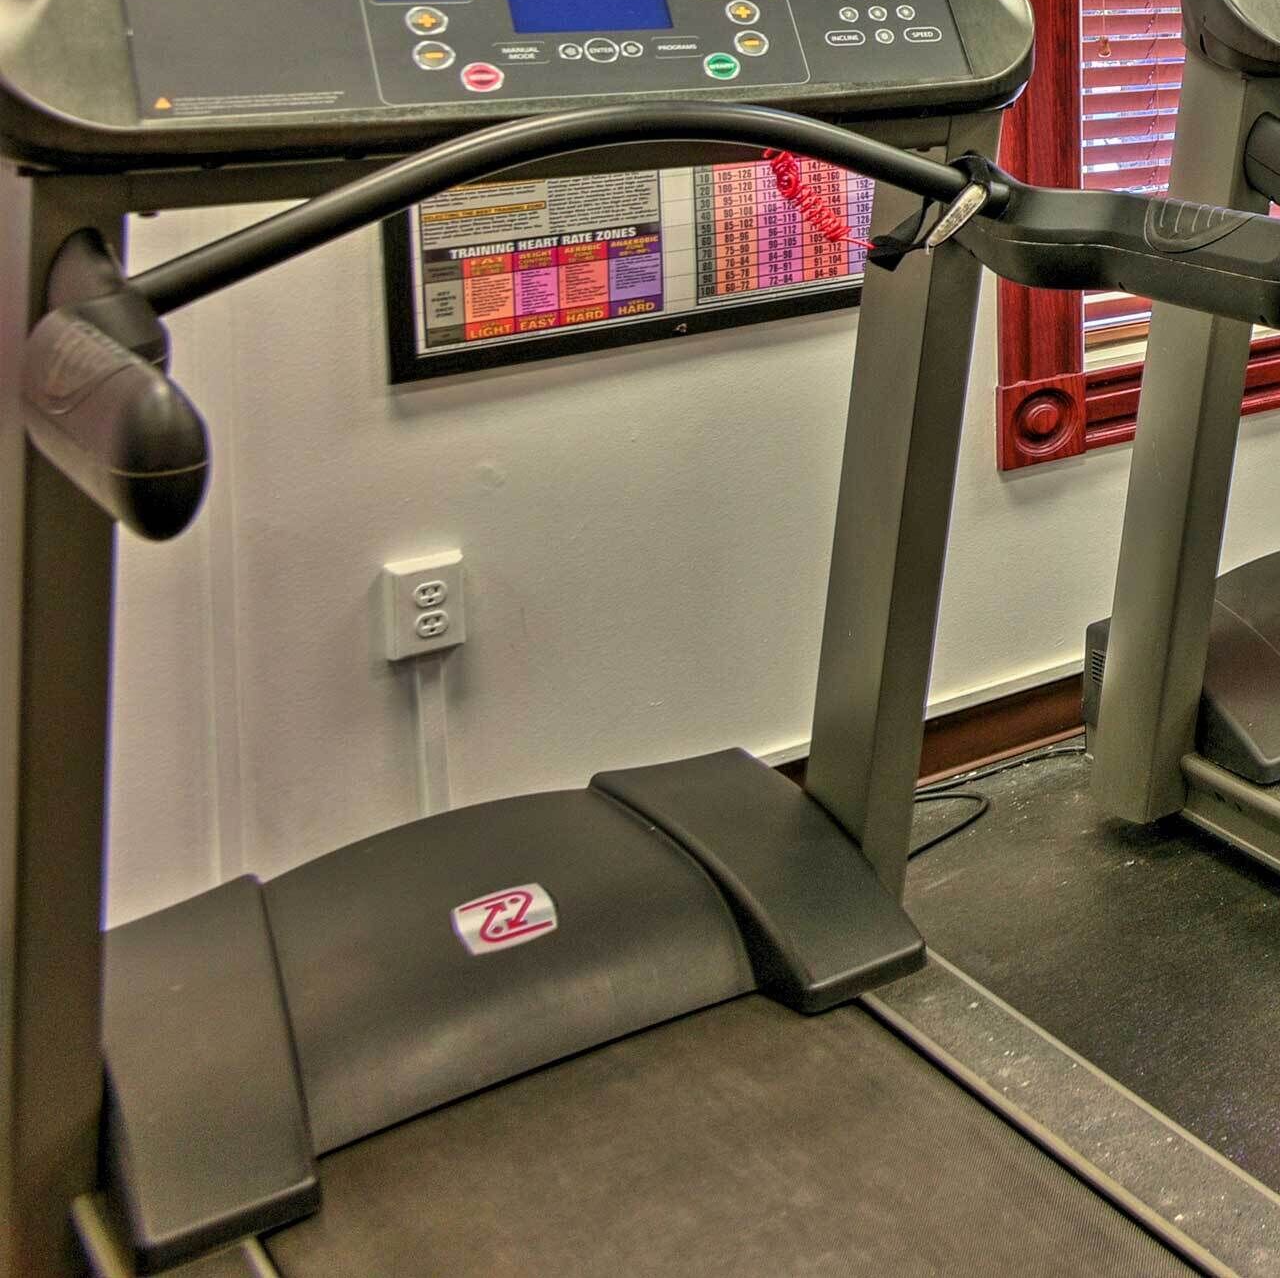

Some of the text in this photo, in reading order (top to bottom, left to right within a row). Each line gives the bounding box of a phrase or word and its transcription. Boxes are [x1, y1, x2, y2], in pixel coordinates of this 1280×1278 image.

[831, 34, 860, 42] INCLINE
[912, 31, 934, 39] SPEED
[657, 43, 698, 51] PROGRAMS
[724, 218, 754, 230] 85-102
[450, 227, 637, 260] TRAINING HEART RATE ZONES
[725, 244, 750, 255] 75-90
[814, 255, 842, 266] 91-104
[725, 280, 750, 292] 60-72
[769, 274, 793, 285] 72-84
[618, 301, 655, 316] HARD
[566, 309, 604, 323] HARD
[470, 323, 513, 339] LIGHT
[519, 317, 556, 331] EASY
